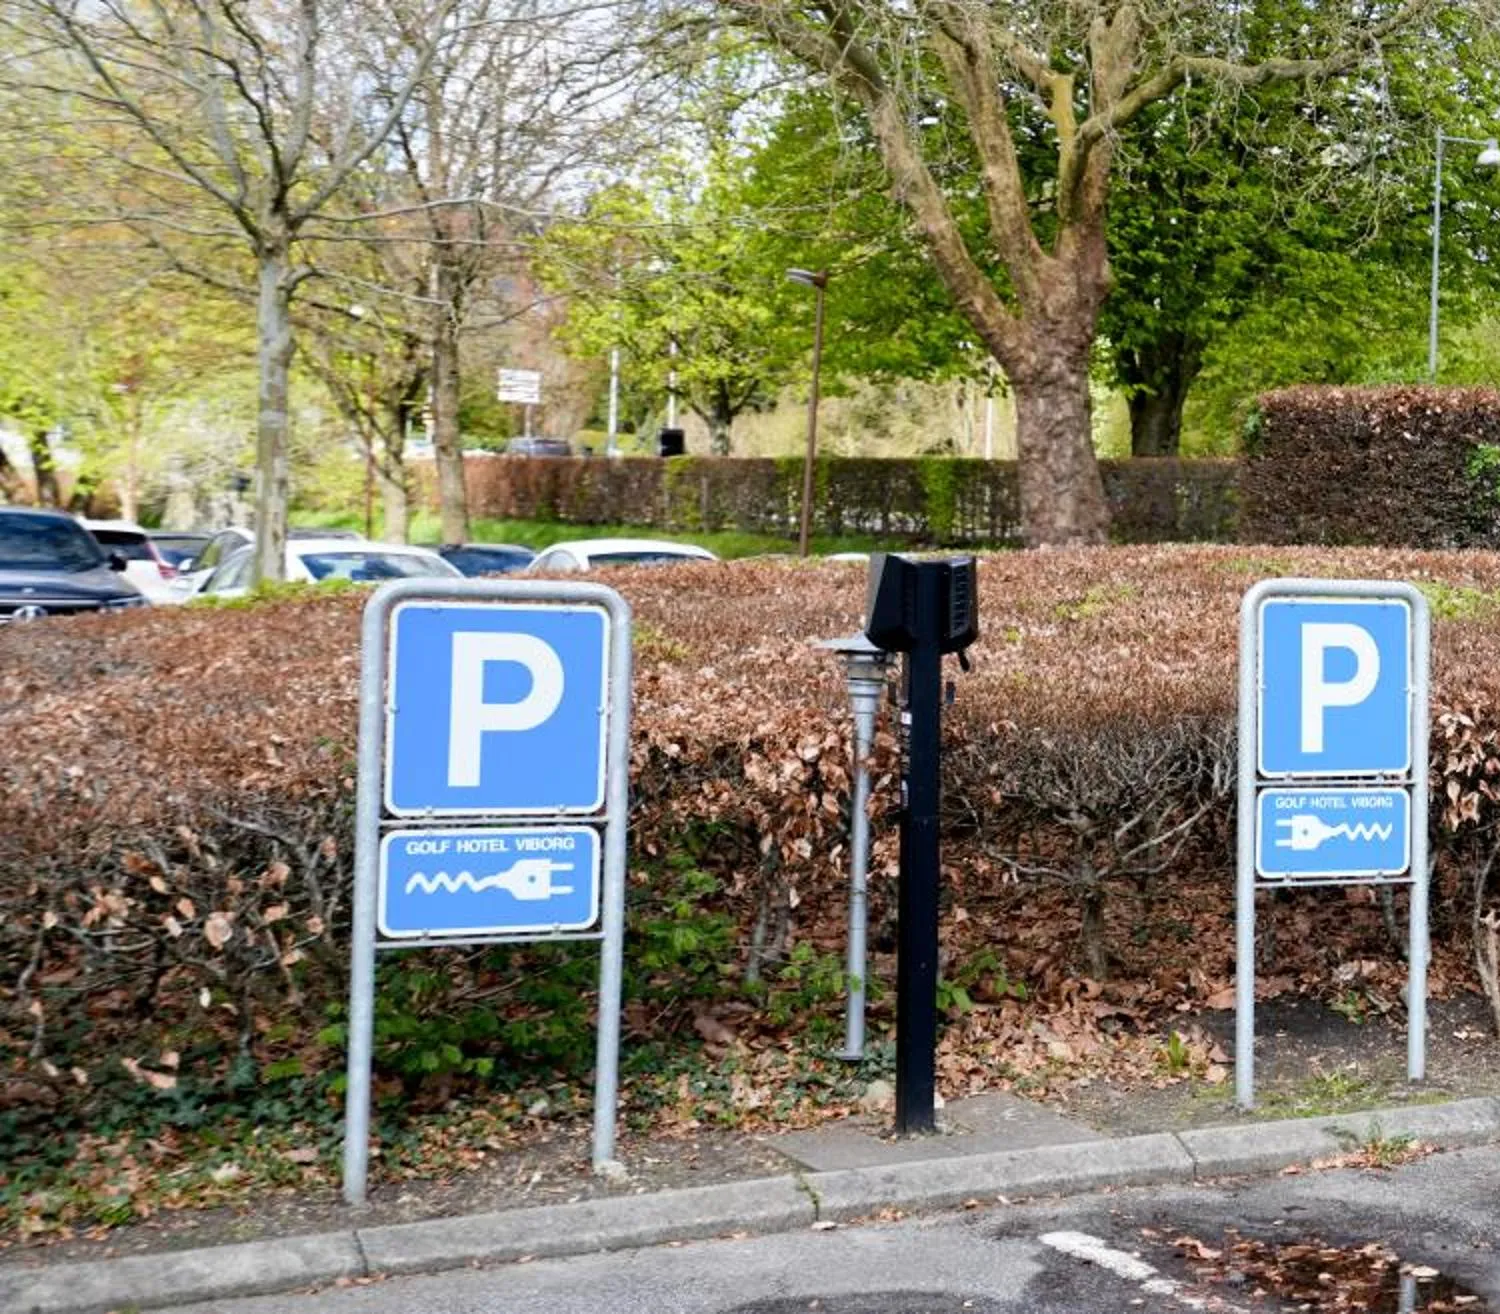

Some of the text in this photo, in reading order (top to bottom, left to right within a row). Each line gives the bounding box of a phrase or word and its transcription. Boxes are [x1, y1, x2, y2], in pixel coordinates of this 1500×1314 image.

[448, 632, 565, 787] P
[1302, 623, 1380, 753] P
[1275, 796, 1307, 809] GOLF
[1311, 796, 1347, 808] HOTEL
[406, 836, 575, 855] GOLF HOTEL VIBORG
